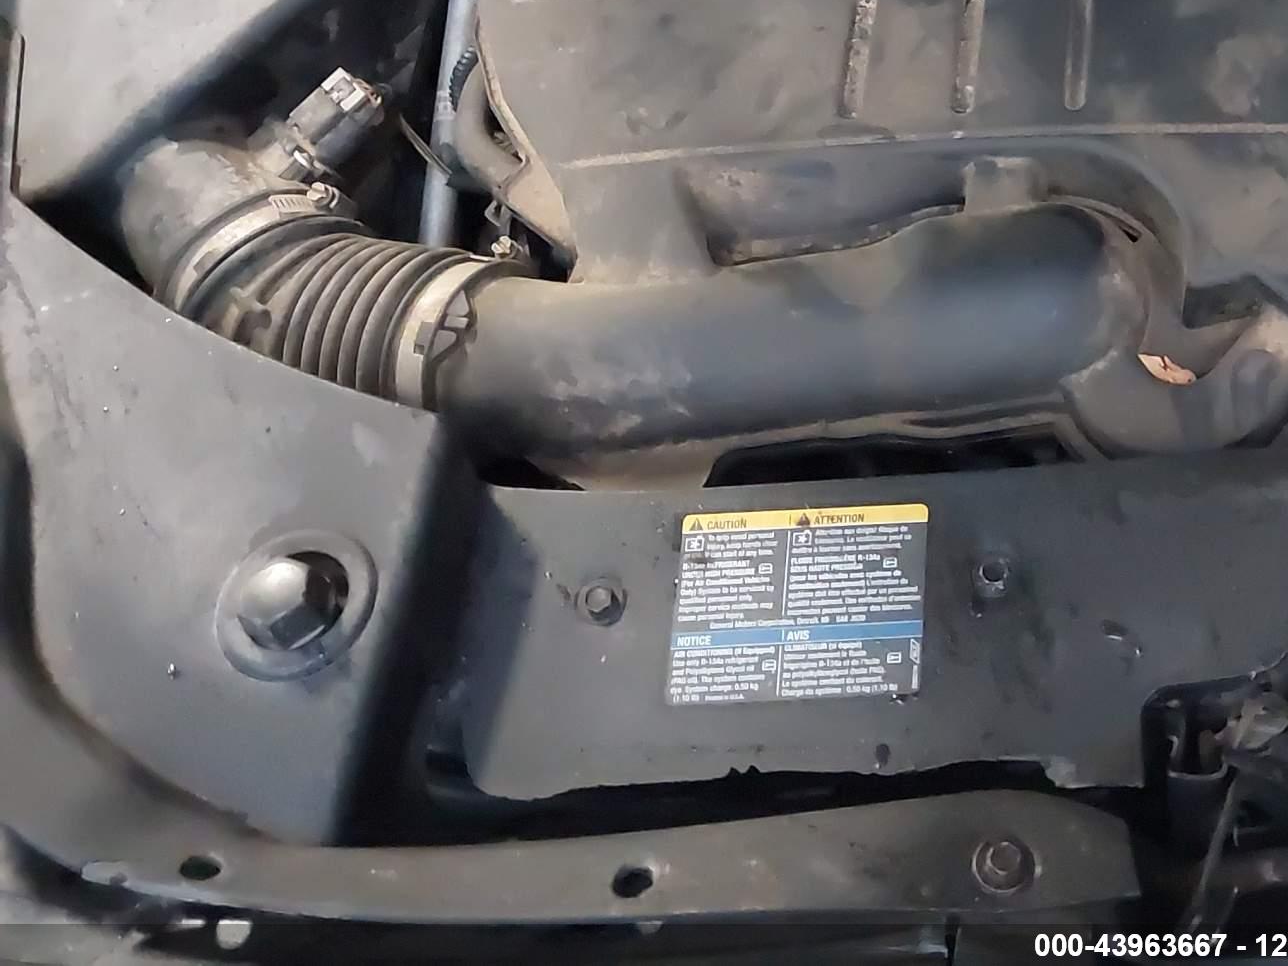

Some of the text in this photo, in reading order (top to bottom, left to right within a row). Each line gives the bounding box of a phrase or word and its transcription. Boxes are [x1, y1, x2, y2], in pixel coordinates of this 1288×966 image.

[707, 518, 747, 530] CAUTION
[813, 513, 865, 524] ATTENTION
[787, 630, 810, 641] AVIS
[677, 636, 712, 647] NOTICE
